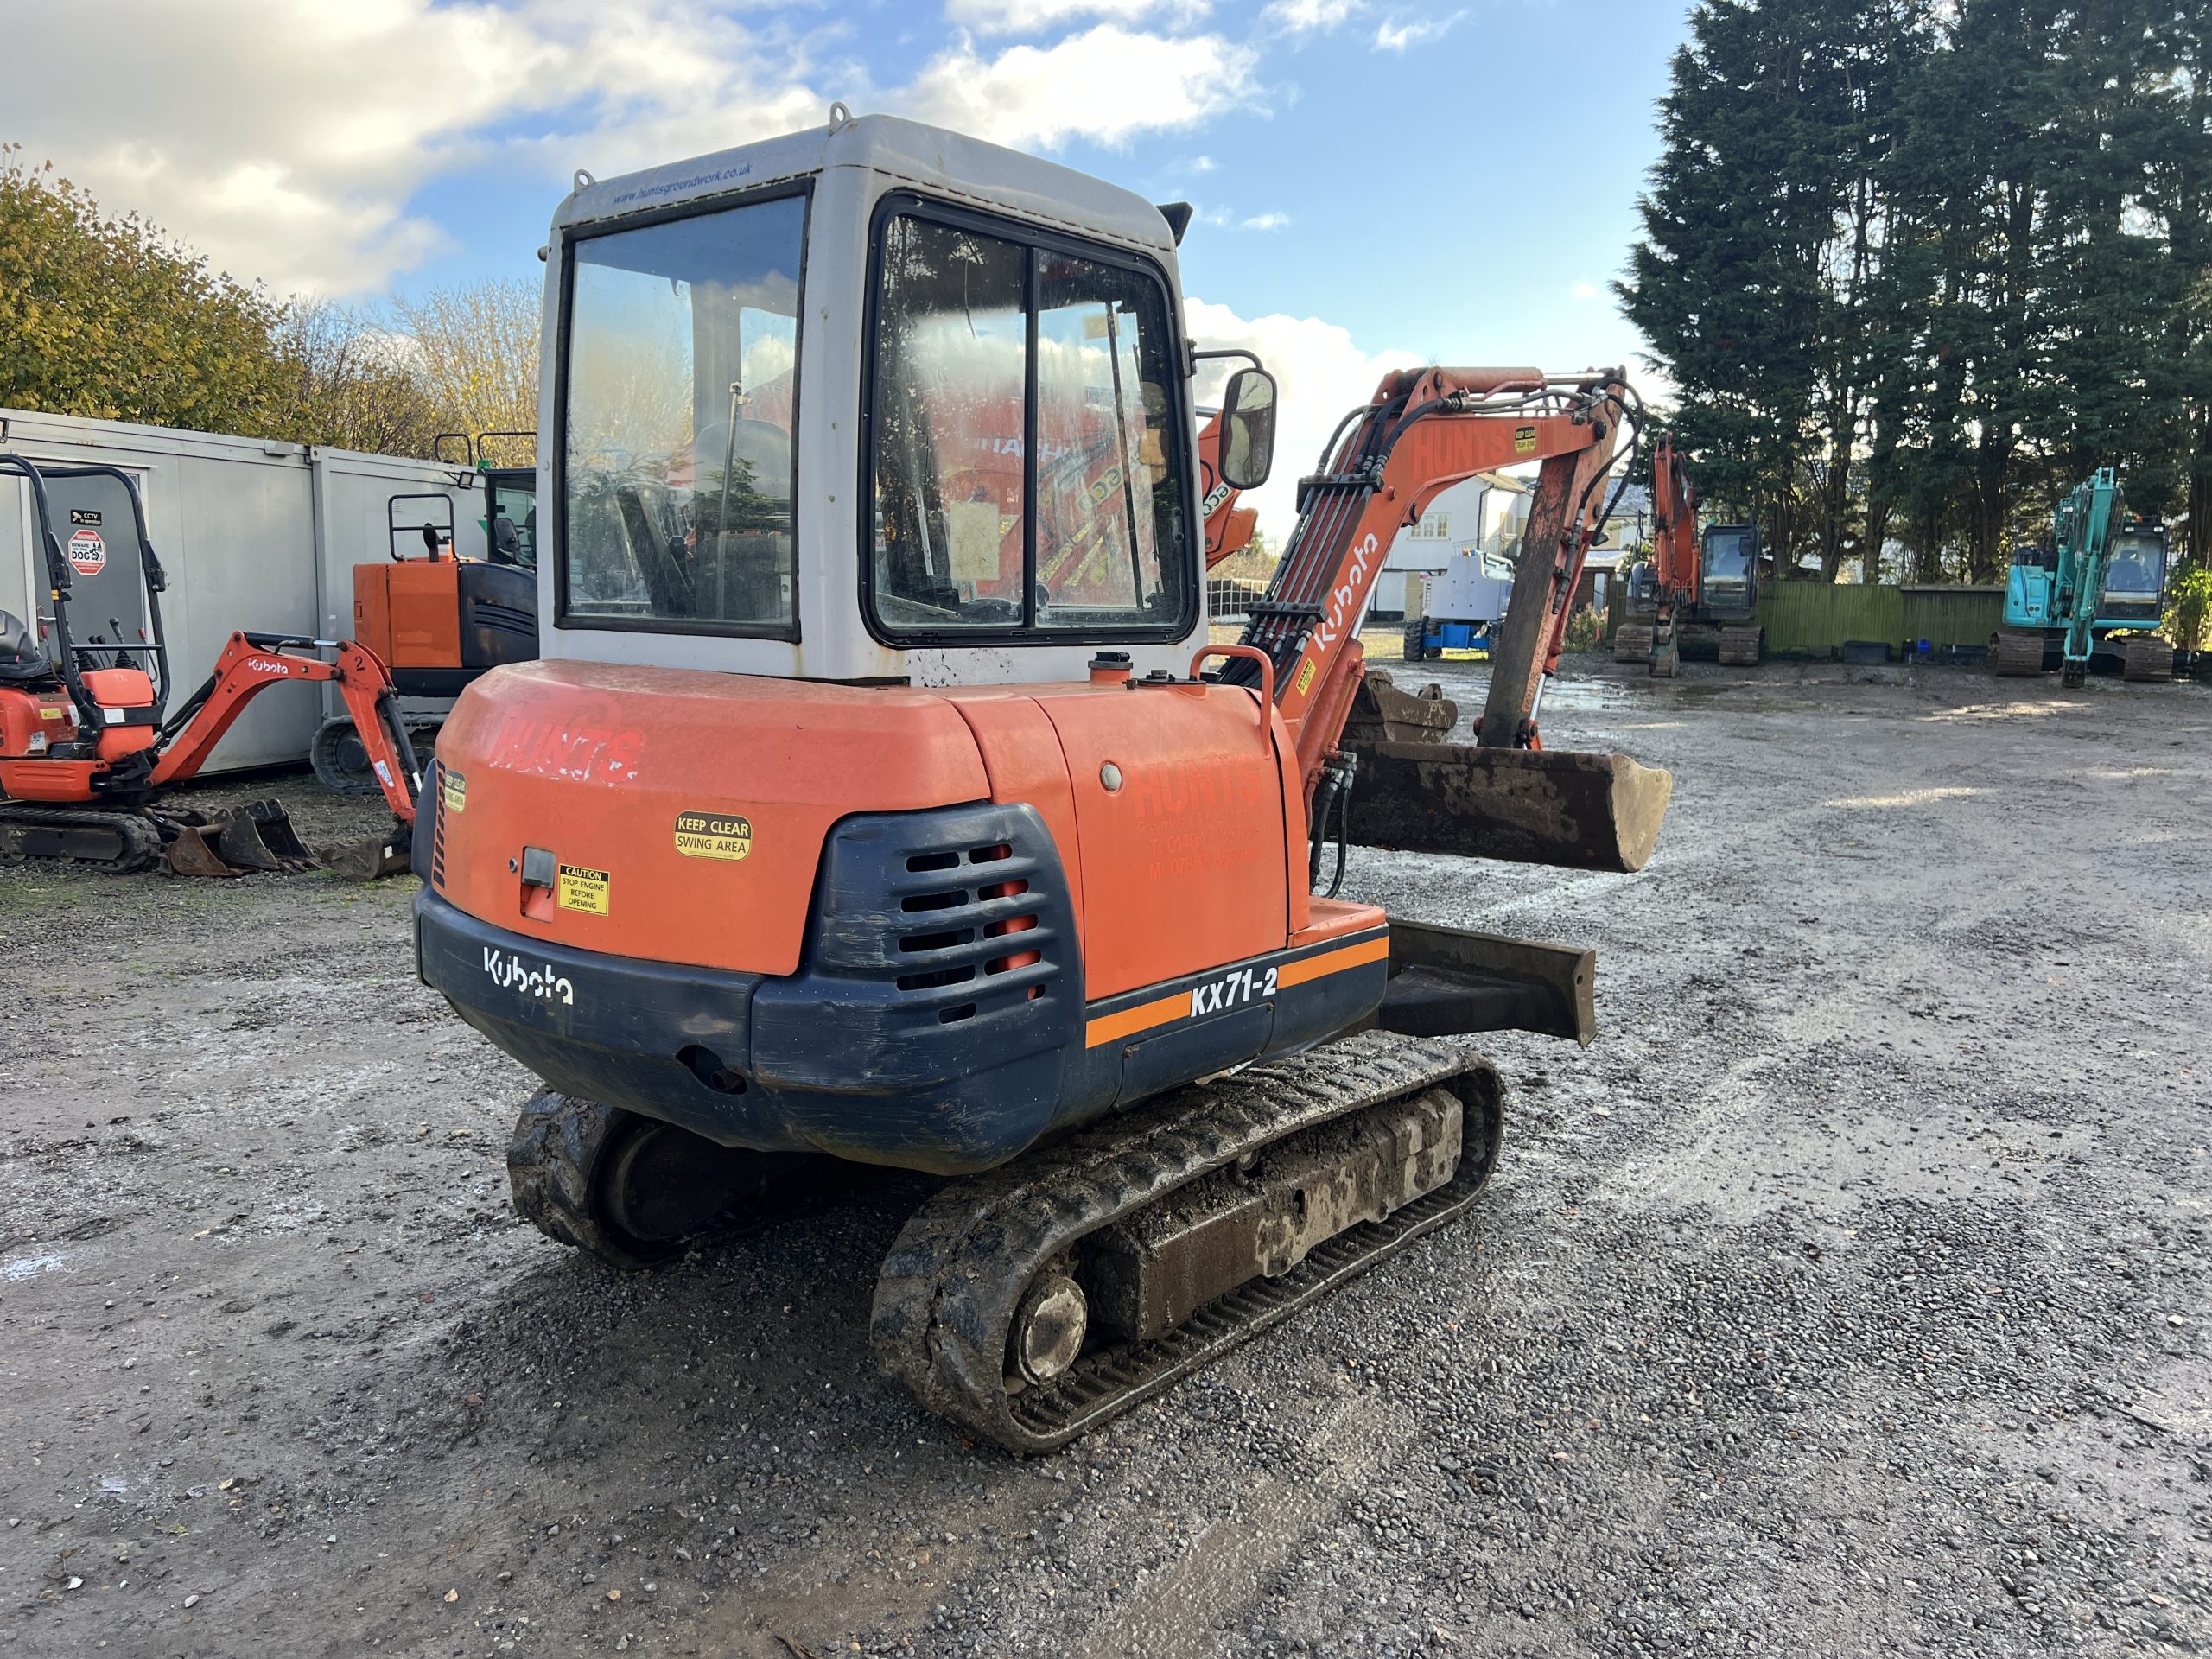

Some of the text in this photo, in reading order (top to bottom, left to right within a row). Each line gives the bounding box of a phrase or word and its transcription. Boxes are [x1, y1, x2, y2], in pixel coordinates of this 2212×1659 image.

[614, 163, 753, 204] www.huntsgroundwork.co.uk
[1414, 422, 1508, 480] HUNTS
[72, 551, 90, 560] DOG
[1313, 532, 1379, 652] Kubota
[248, 658, 289, 675] Kubota
[354, 656, 365, 671] 2
[489, 718, 644, 785] HUNTS
[677, 817, 749, 836] KEEP CLEAR
[677, 836, 747, 853] SWING AREA
[566, 867, 602, 880] CAUTION
[563, 877, 604, 892] STOP ENGINE
[570, 888, 594, 899] BEFORE
[568, 898, 597, 909] OPENING
[484, 946, 574, 1006] Kubota
[1190, 967, 1278, 1018] KX71-2
